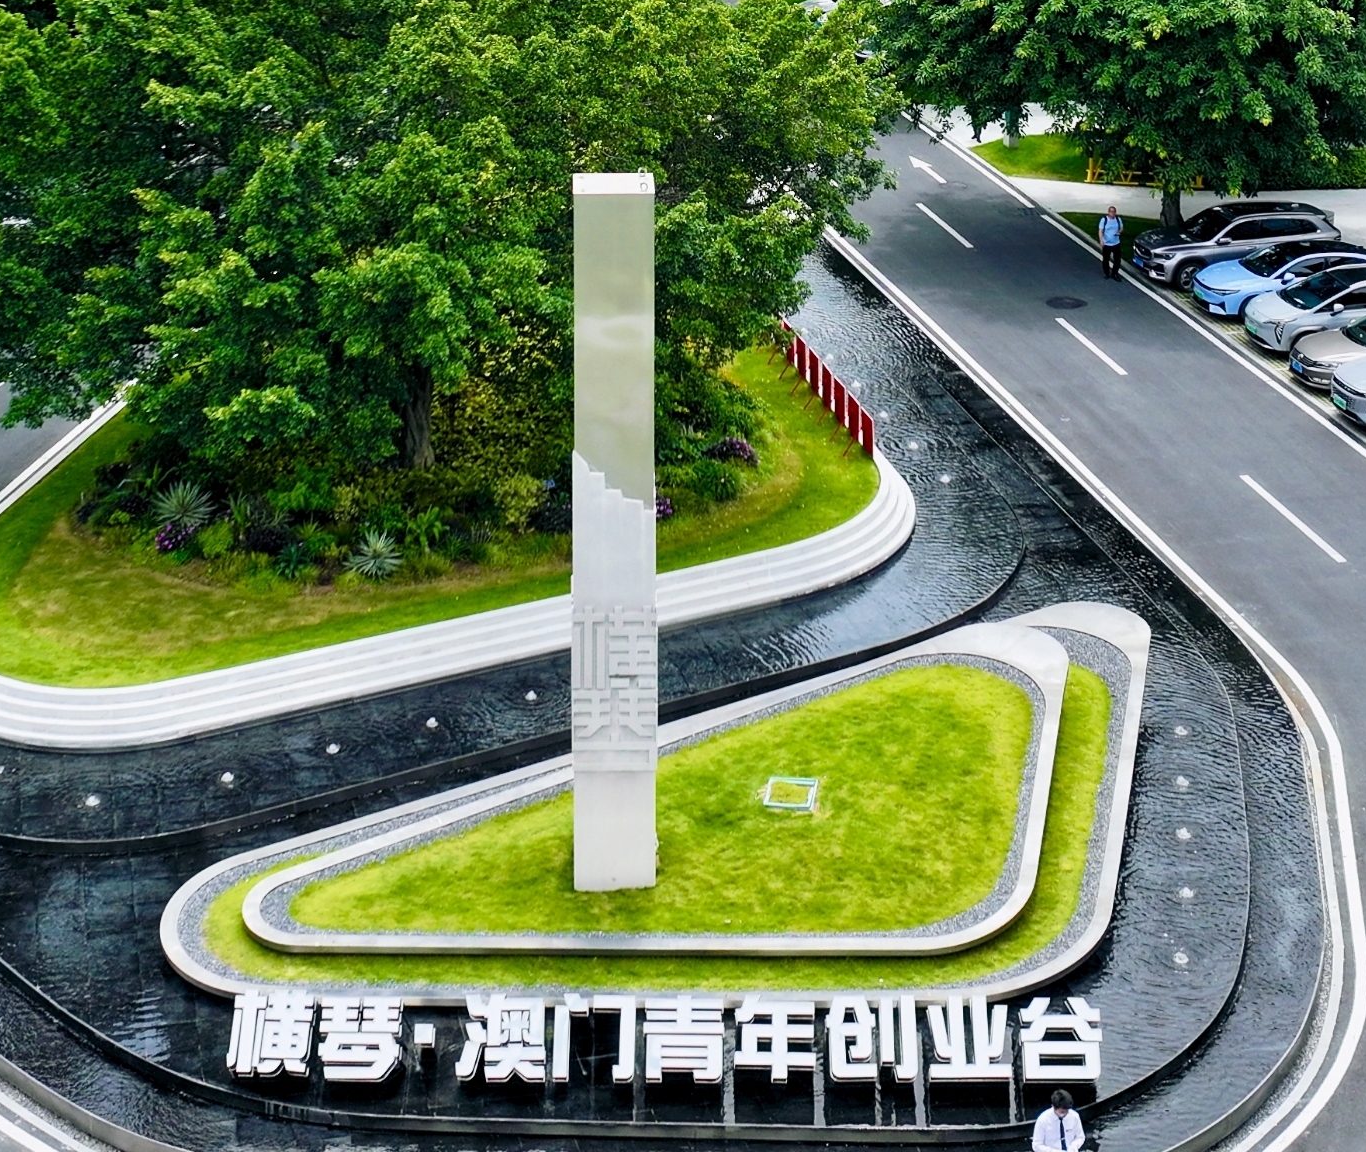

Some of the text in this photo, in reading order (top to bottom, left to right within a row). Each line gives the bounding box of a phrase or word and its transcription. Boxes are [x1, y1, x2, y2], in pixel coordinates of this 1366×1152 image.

[225, 991, 1102, 1084] 横琴·澳门青年创业谷
